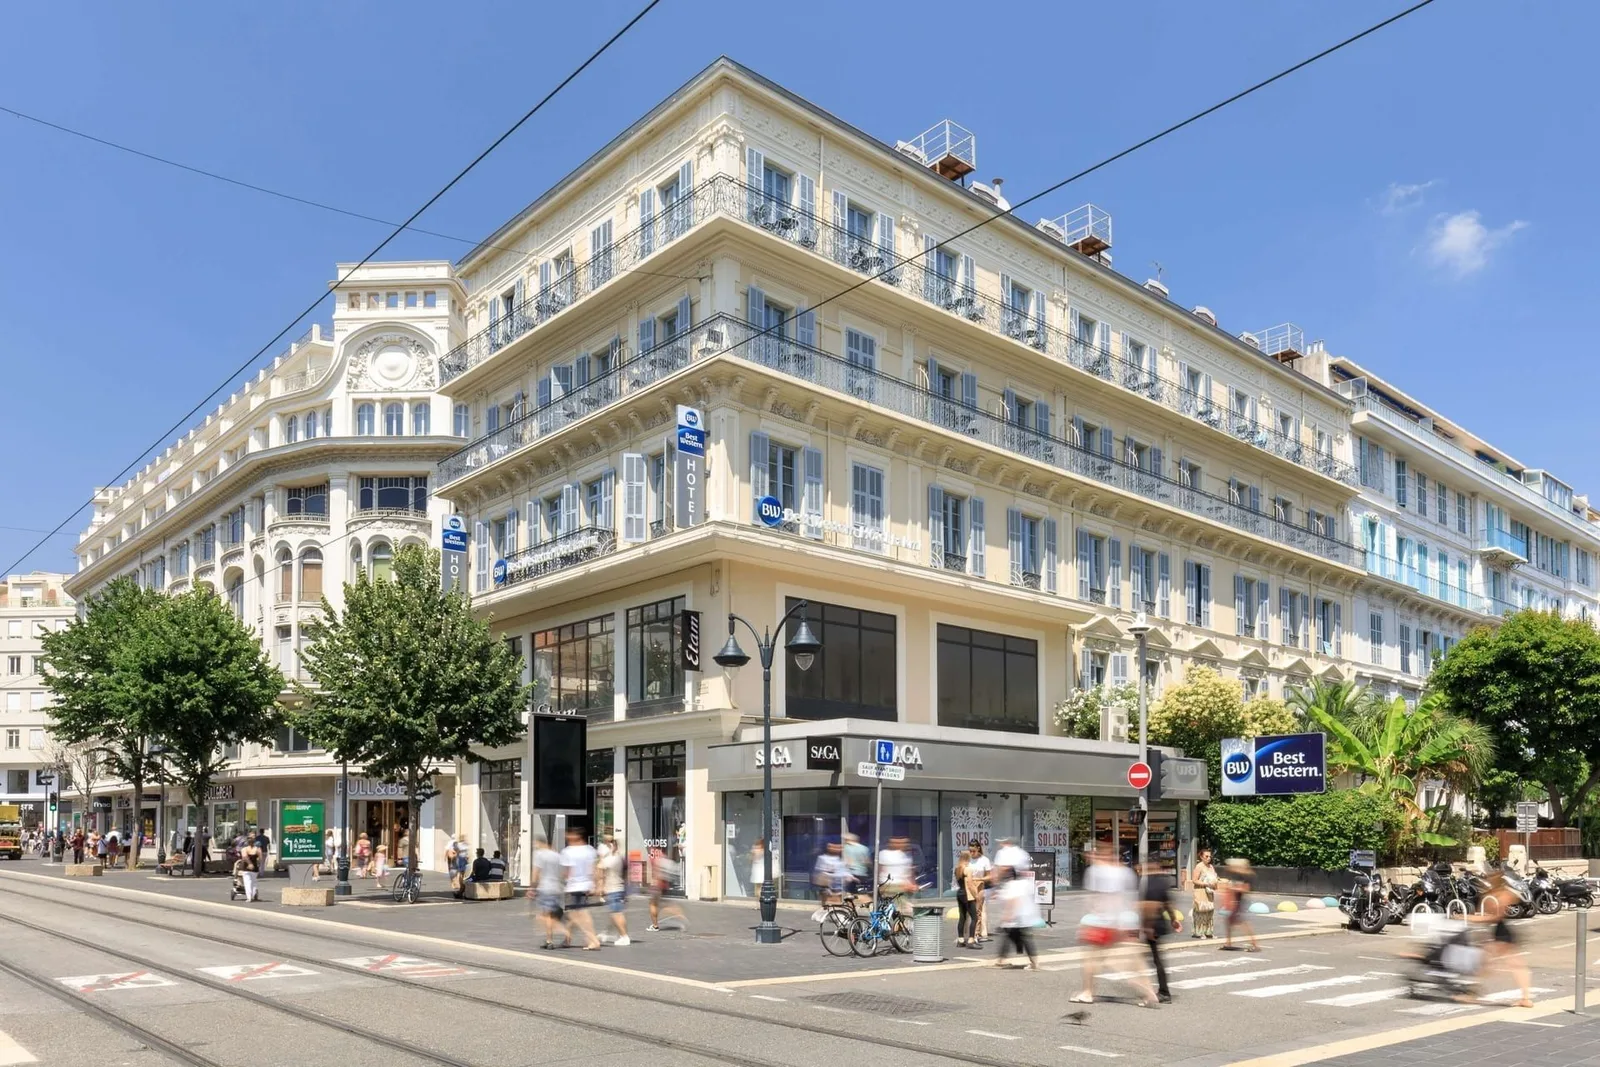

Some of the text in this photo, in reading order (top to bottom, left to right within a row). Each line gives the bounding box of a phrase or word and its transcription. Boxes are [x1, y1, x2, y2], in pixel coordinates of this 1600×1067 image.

[685, 432, 698, 441] Best
[686, 458, 696, 527] HOTEL
[762, 504, 781, 518] BW
[686, 615, 699, 666] Etam
[756, 746, 792, 765] SGA
[811, 745, 840, 759] SAGA
[893, 745, 923, 764] AGA
[1273, 752, 1305, 764] Best
[1227, 761, 1249, 774] BW
[337, 780, 430, 795] PULL&BE
[643, 838, 668, 848] SOLDES
[956, 832, 989, 846] SOLDES
[1038, 833, 1067, 847] SOLDES
